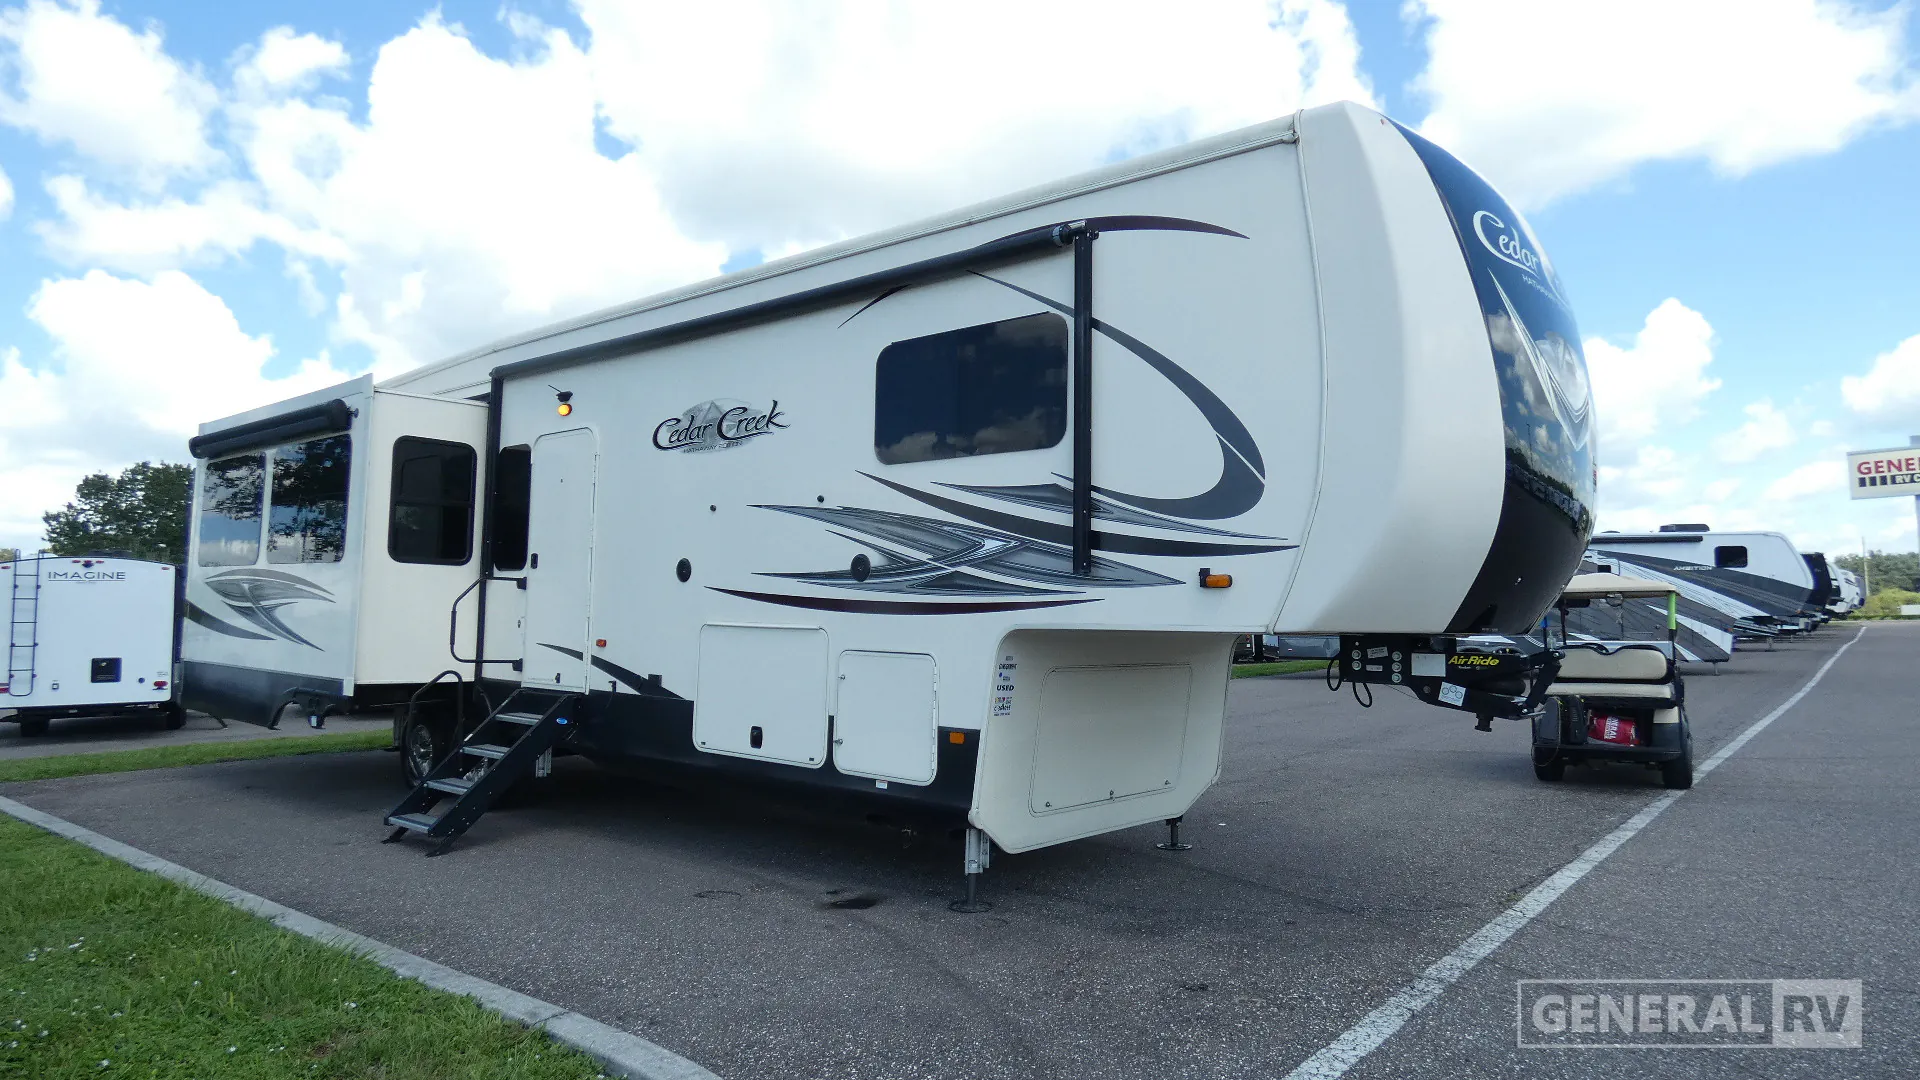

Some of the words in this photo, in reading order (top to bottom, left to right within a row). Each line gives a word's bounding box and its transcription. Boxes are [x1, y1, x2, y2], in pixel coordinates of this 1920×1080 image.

[1472, 210, 1541, 280] Cedar
[652, 414, 713, 451] Cedar
[716, 399, 790, 441] Creek
[1857, 456, 1920, 475] GENE
[47, 571, 126, 580] IMAGINE
